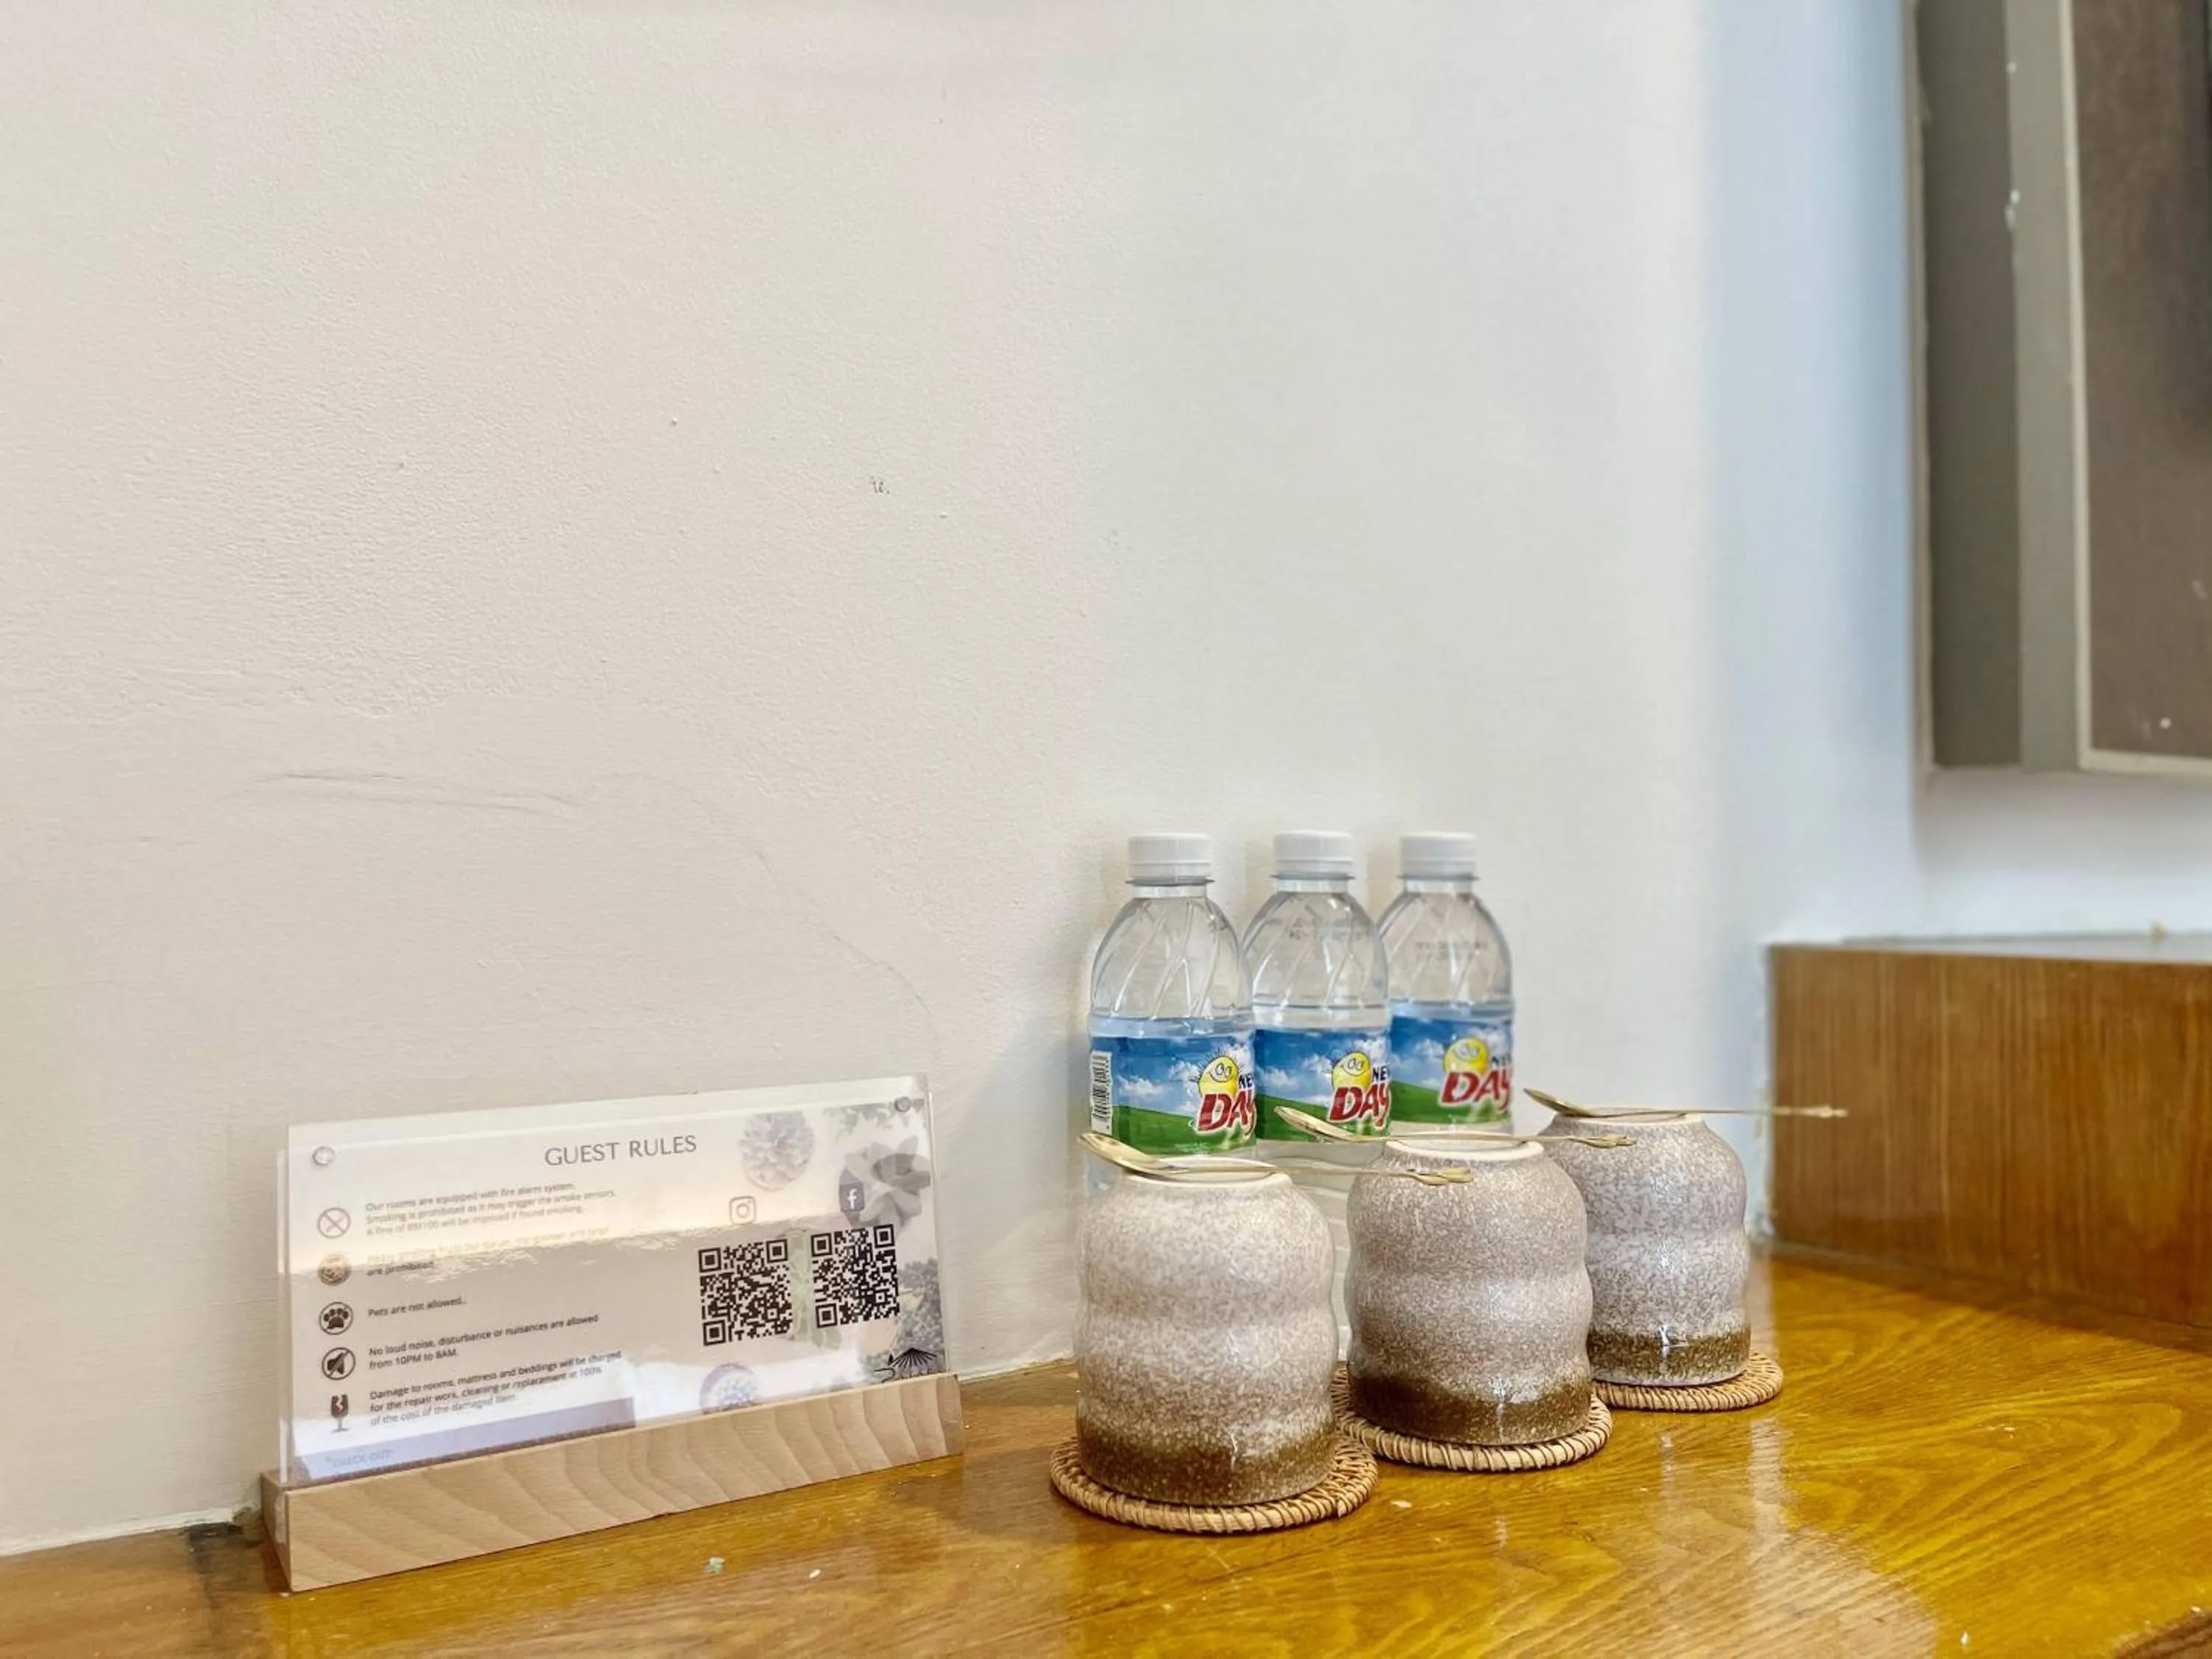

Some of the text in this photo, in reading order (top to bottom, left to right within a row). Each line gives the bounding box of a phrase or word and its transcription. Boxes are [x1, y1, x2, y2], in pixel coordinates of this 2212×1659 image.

[544, 1135, 697, 1166] GUEST RULES
[366, 1202, 384, 1211] Our
[386, 1199, 416, 1209] rooms
[419, 1197, 434, 1206] are
[367, 1307, 389, 1318] Pets
[391, 1304, 406, 1314] are
[408, 1301, 425, 1312] not
[369, 1346, 383, 1356] No
[386, 1343, 406, 1354] loud
[437, 1331, 492, 1346] disturbance
[493, 1329, 503, 1338] or
[505, 1322, 548, 1336] nuisances
[550, 1320, 563, 1329] are
[566, 1313, 599, 1326] allowed
[369, 1359, 393, 1370] from
[396, 1354, 422, 1365] 10PM
[423, 1352, 434, 1361] to
[369, 1387, 409, 1400] Damage
[411, 1384, 420, 1393] to
[458, 1372, 497, 1386] mattress
[499, 1368, 516, 1378] and
[518, 1363, 558, 1377] beddings
[560, 1357, 574, 1368] will
[576, 1356, 586, 1366] be
[369, 1402, 383, 1413] for
[385, 1399, 403, 1411] the
[404, 1394, 431, 1408] repair
[461, 1382, 500, 1398] cleaning
[501, 1381, 511, 1391] or
[512, 1371, 567, 1391] replacement
[371, 1414, 381, 1425] of
[383, 1412, 398, 1423] the
[422, 1405, 432, 1416] of
[434, 1404, 449, 1415] the
